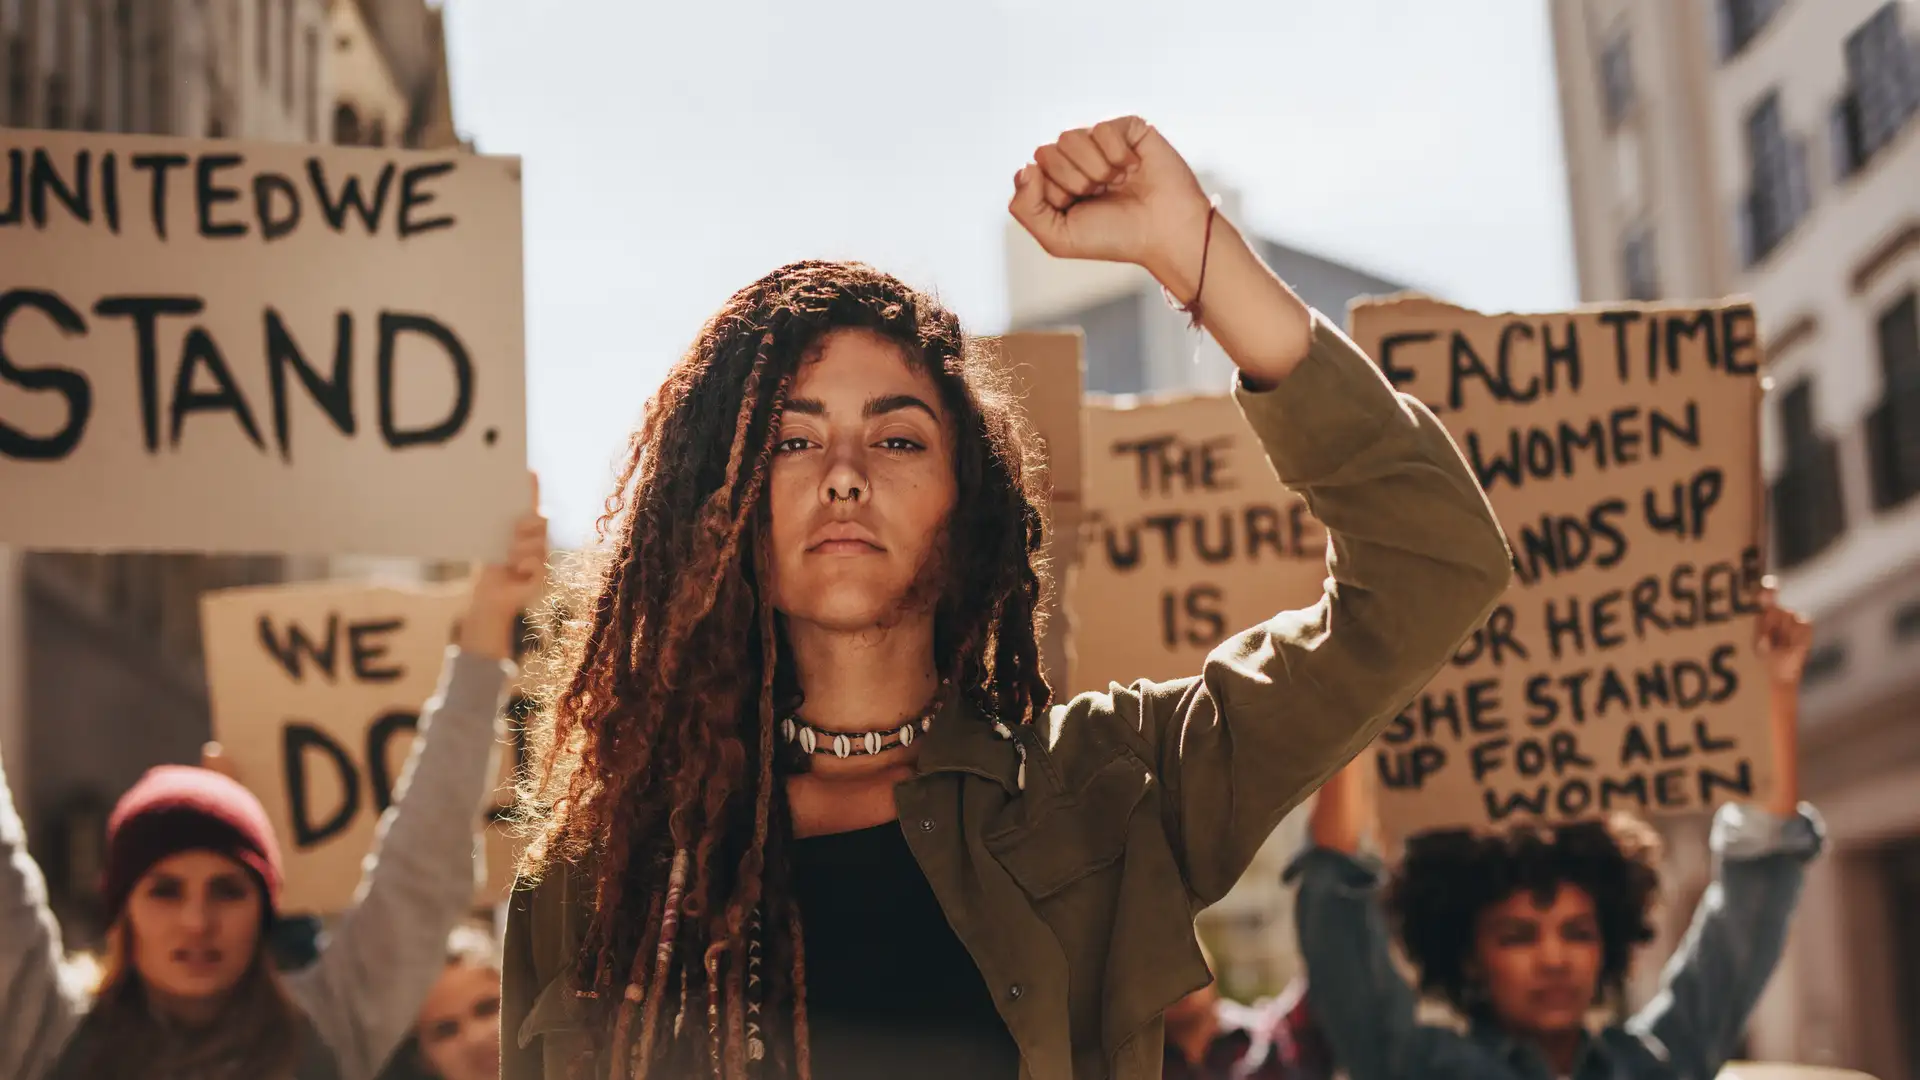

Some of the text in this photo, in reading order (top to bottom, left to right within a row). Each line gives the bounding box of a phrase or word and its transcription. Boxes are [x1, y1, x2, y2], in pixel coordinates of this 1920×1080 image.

[306, 154, 458, 241] WE
[0, 287, 500, 464] STAND.
[1379, 307, 1758, 411] EACH TIME
[1109, 432, 1237, 497] THE
[1466, 402, 1700, 490] WOMEN
[1643, 467, 1723, 540] UP
[257, 612, 406, 686] WE
[1160, 586, 1228, 652] IS
[1383, 644, 1739, 742] SHE STANDS
[1377, 720, 1736, 789] UP FOR ALL
[1484, 761, 1752, 820] WOMEN
